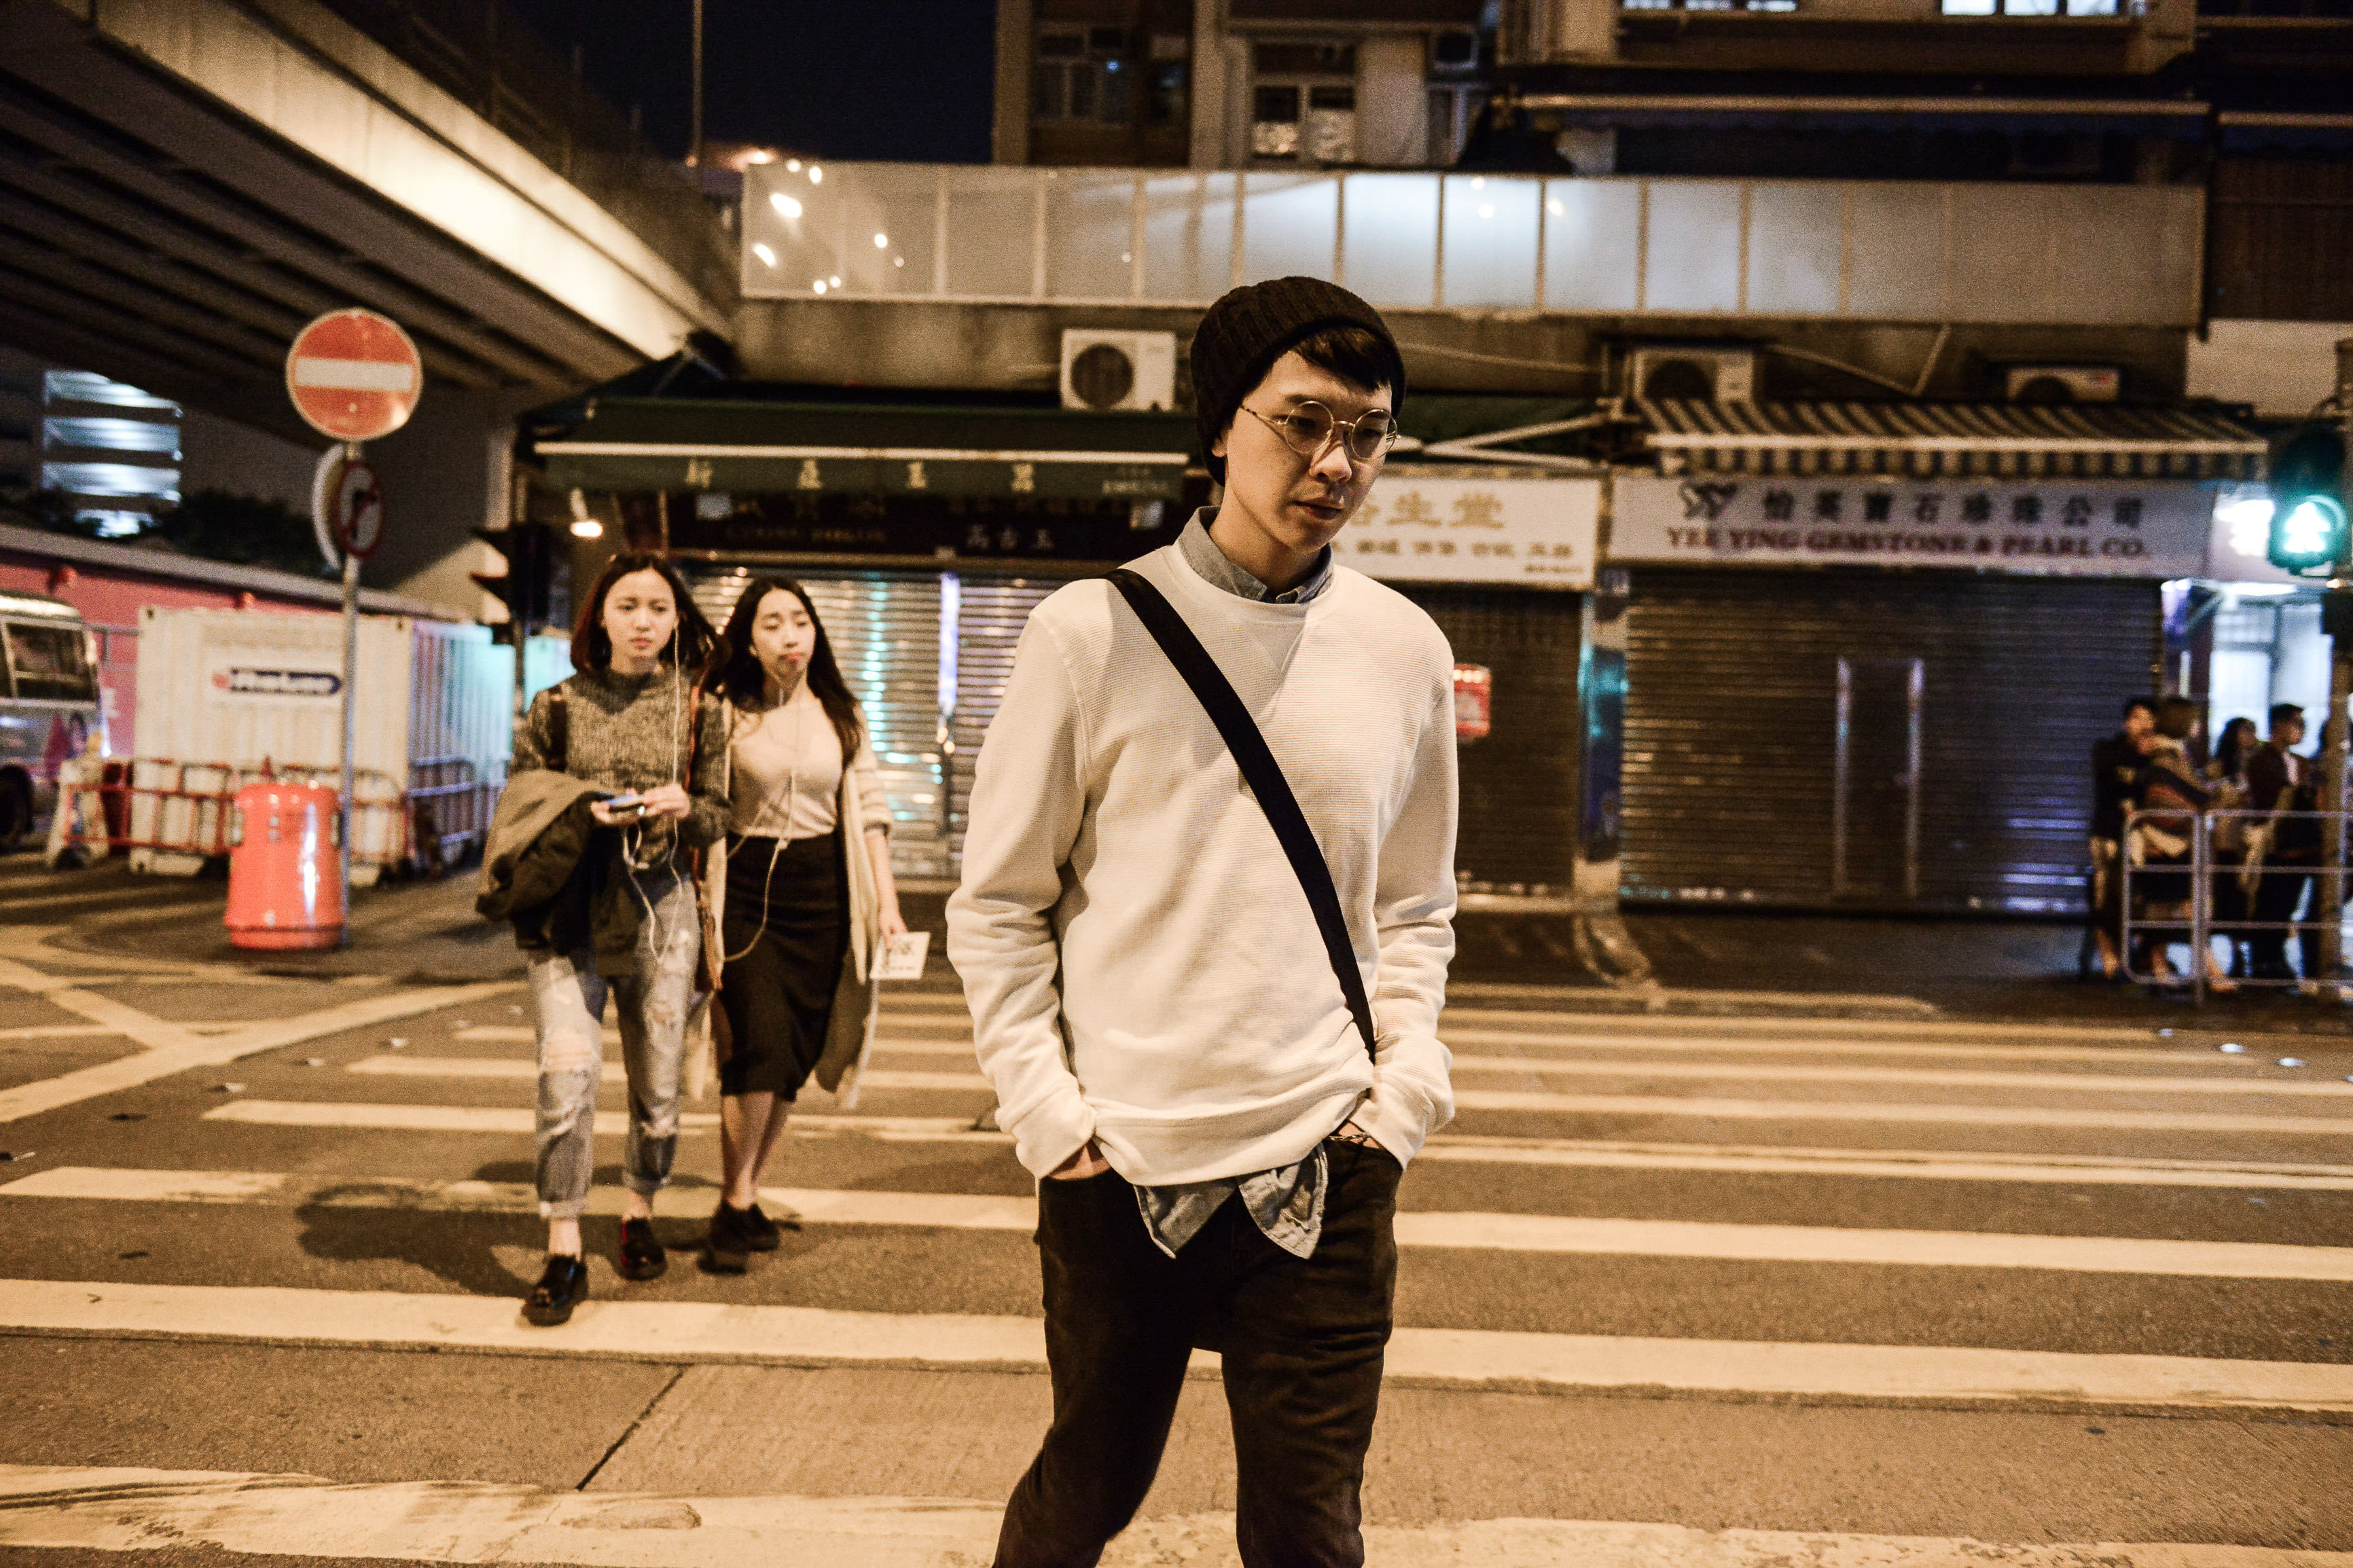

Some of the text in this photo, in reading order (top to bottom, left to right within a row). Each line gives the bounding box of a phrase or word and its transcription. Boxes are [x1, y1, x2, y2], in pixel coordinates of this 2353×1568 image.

[1668, 528, 1718, 548] YEE
[1729, 528, 1800, 550] YING
[1806, 530, 1964, 552] GEMSTONE
[1974, 535, 1993, 554] &
[2001, 536, 2093, 555] PEARL
